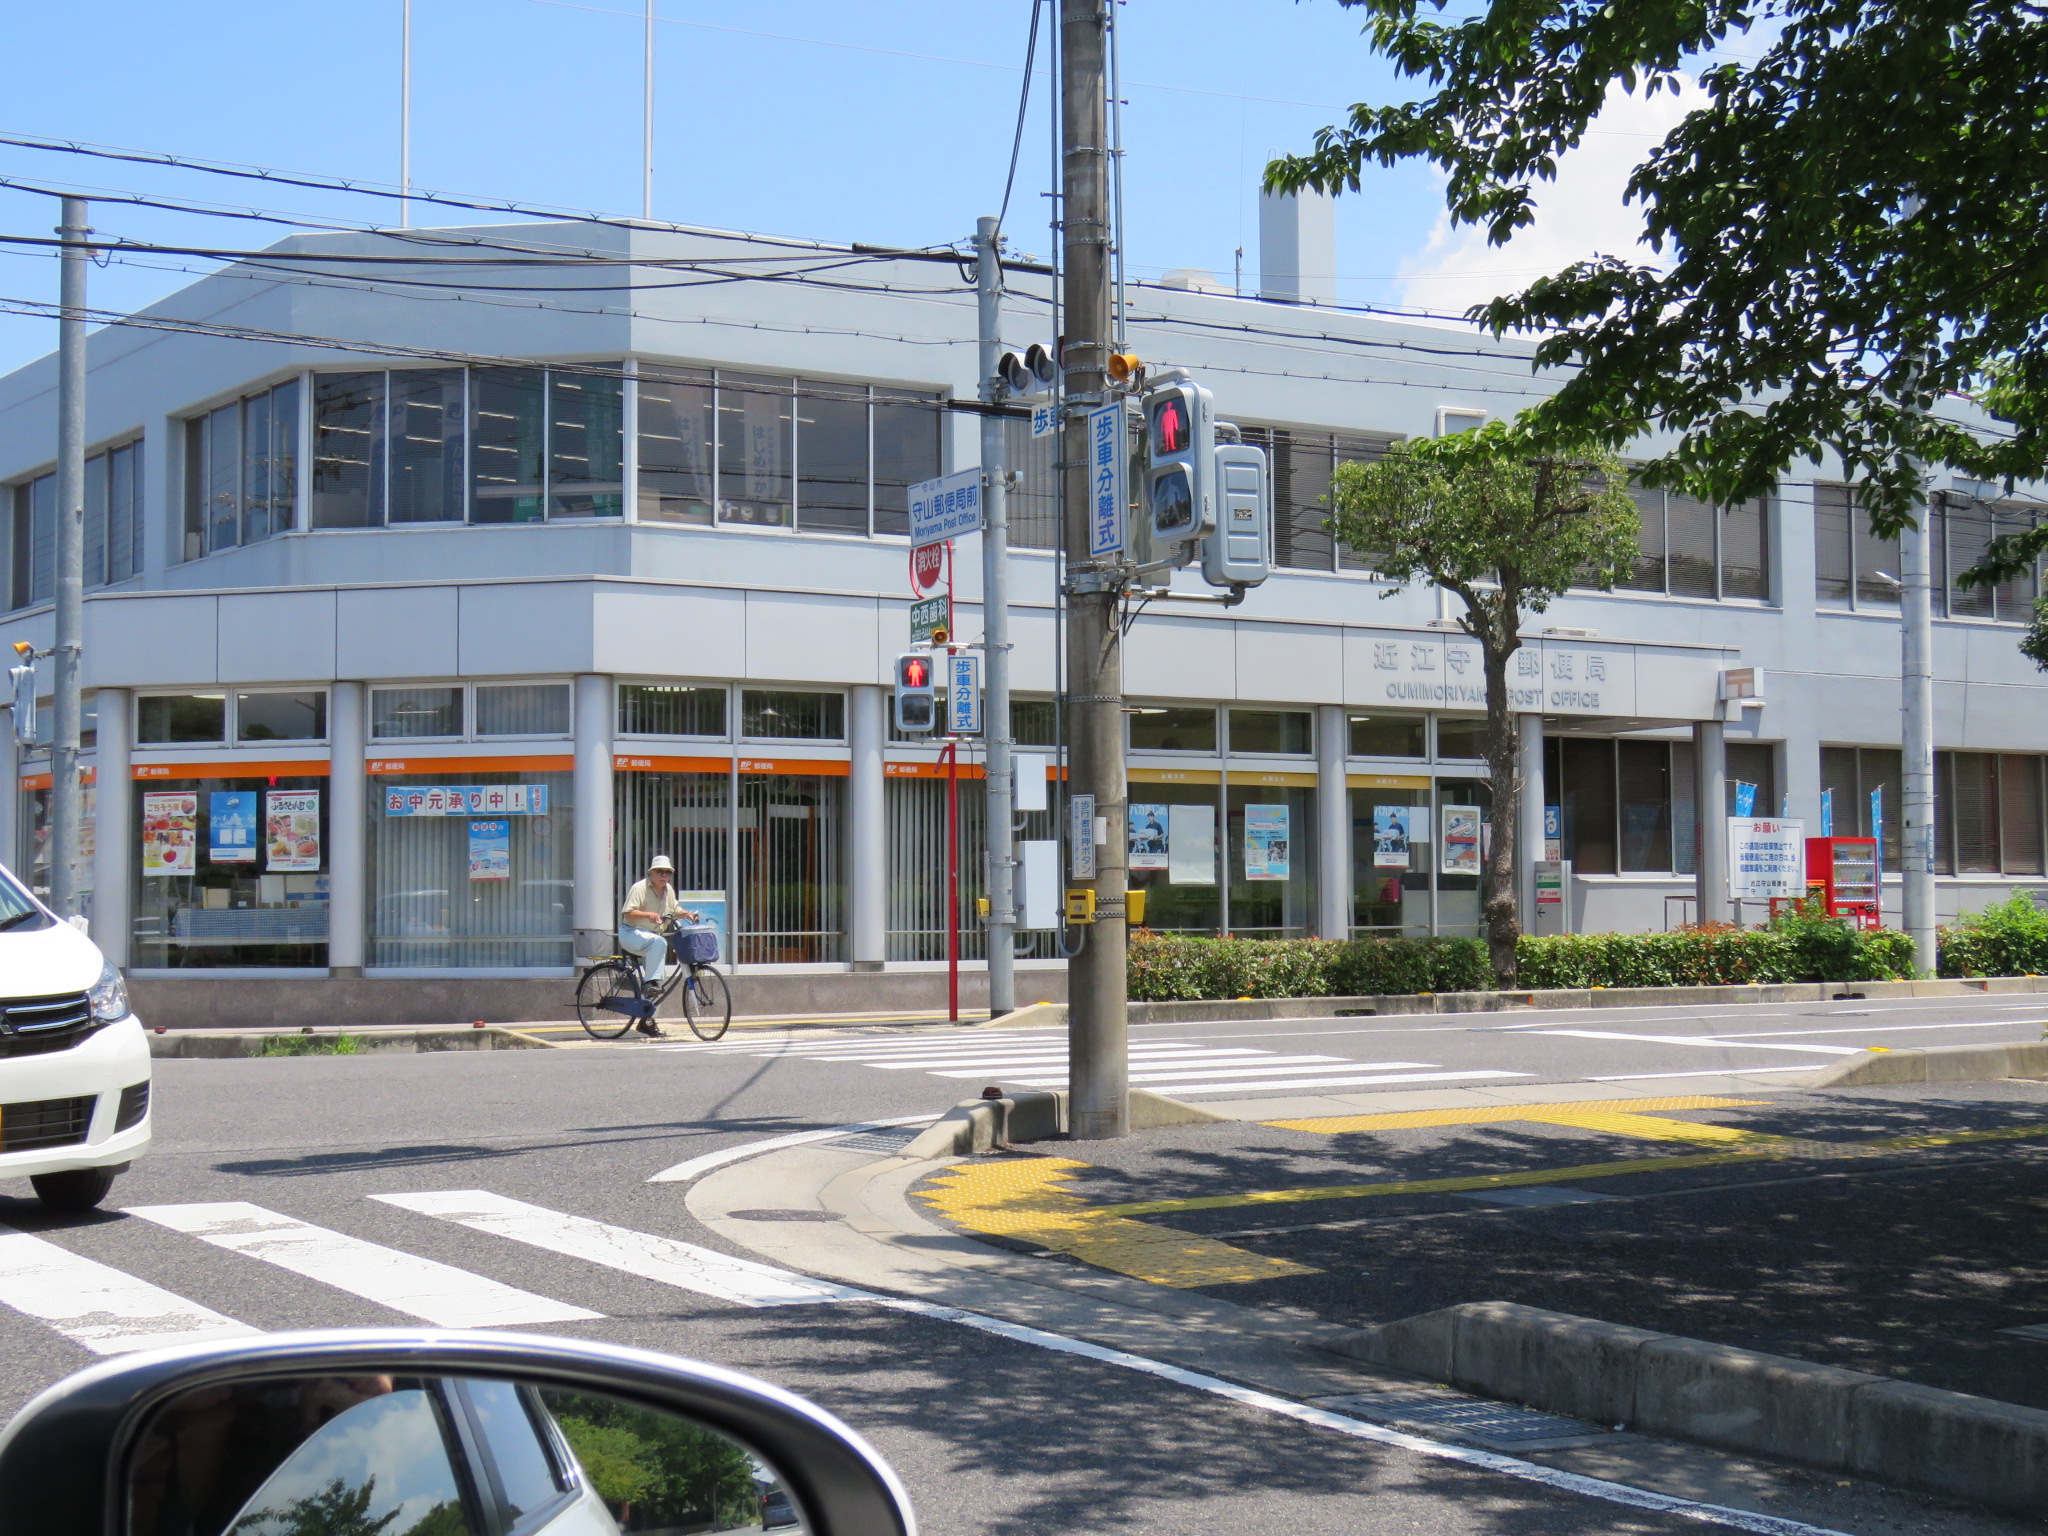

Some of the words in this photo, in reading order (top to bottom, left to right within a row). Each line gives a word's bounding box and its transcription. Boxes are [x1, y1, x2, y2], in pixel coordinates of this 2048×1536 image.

[922, 479, 943, 493] 守山市
[1096, 415, 1115, 546] 歩車分離式
[912, 484, 978, 523] 守山郵便局前
[915, 521, 943, 538] Moriyama
[943, 516, 957, 531] Post
[958, 512, 976, 526] Office
[917, 547, 941, 574] 消火栓
[911, 597, 948, 628] 中西歯科
[1373, 642, 1607, 682] 近江守郵便局
[955, 660, 973, 728] 歩車分離式
[1386, 681, 1488, 704] OUMIMORIYAM
[1551, 690, 1600, 709] OFFICE
[631, 759, 652, 768] 郵便局
[754, 761, 774, 770] 郵便局
[899, 765, 918, 774] 郵便局
[1080, 800, 1091, 875] 歩行者用押ボタン
[1753, 822, 1780, 833] お願い
